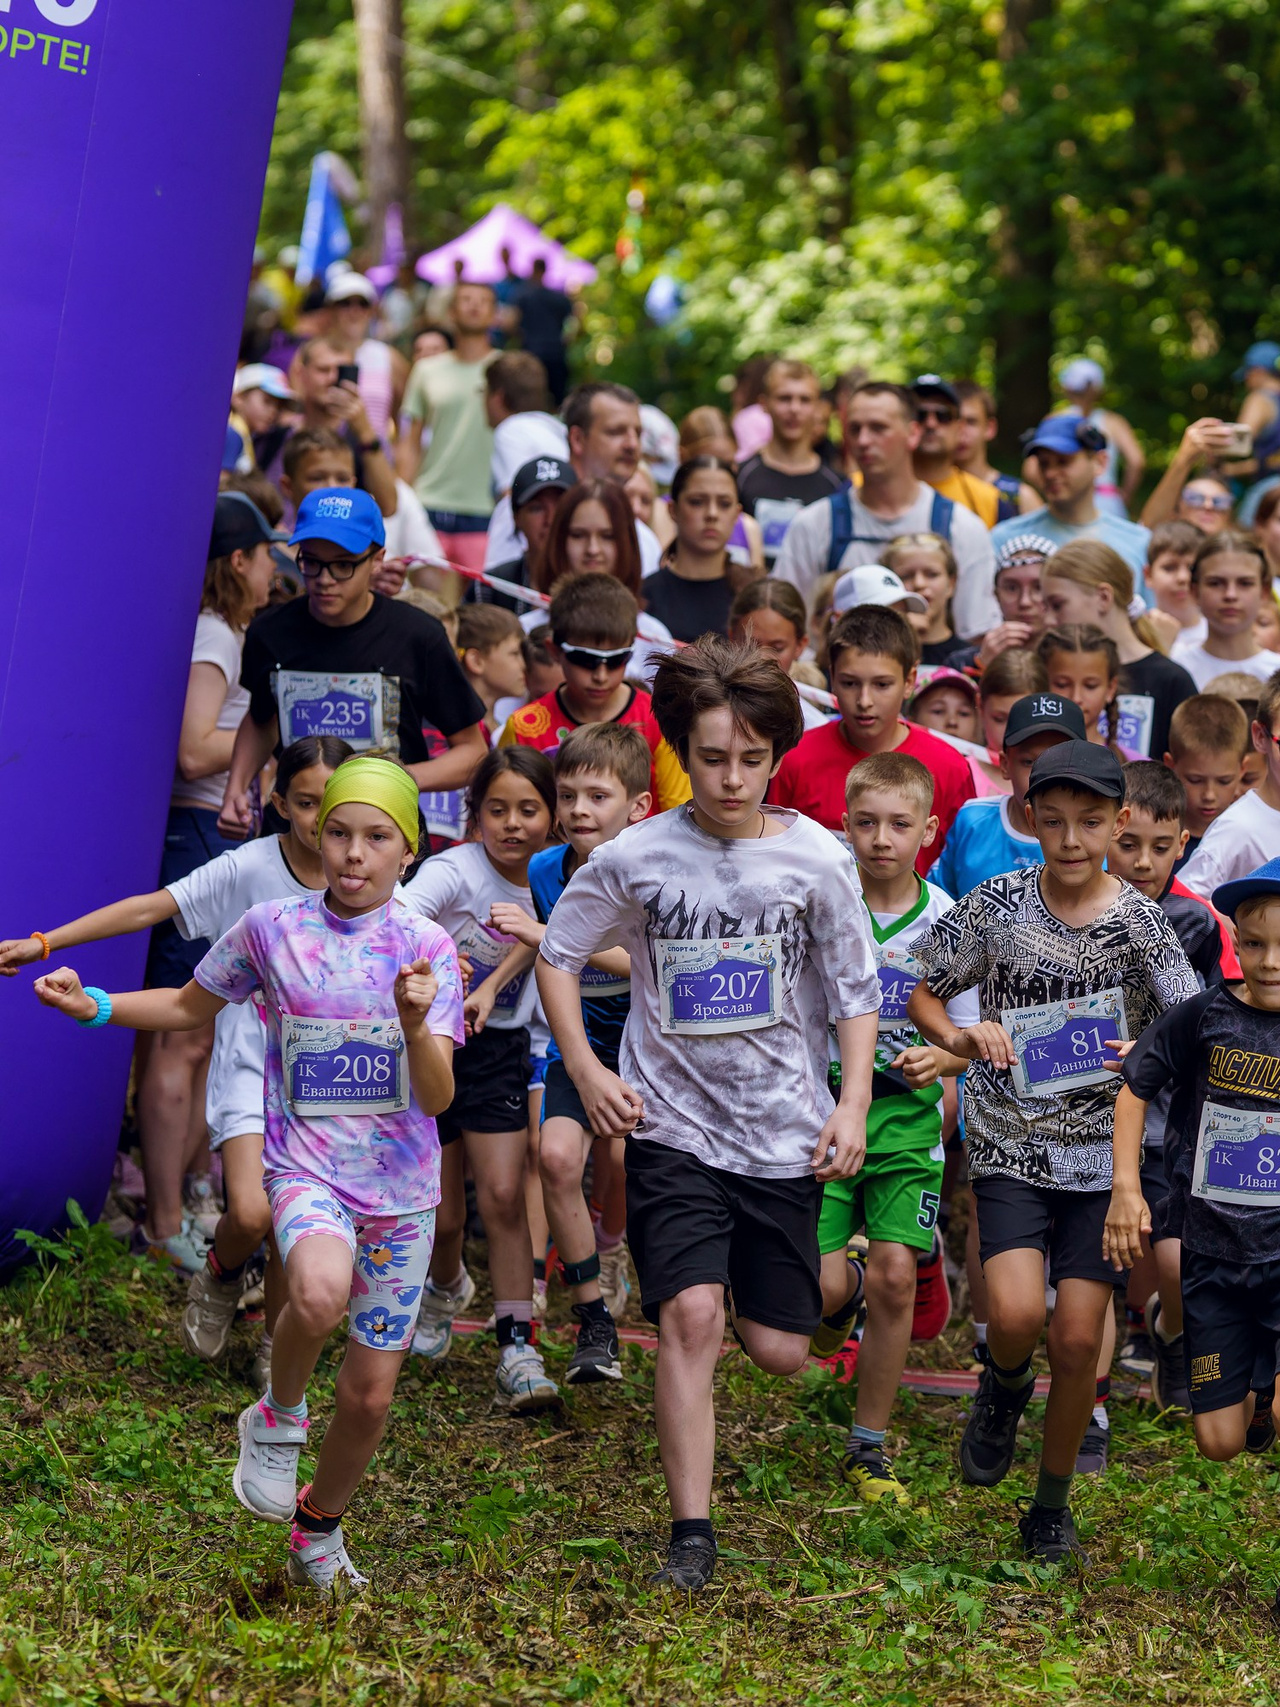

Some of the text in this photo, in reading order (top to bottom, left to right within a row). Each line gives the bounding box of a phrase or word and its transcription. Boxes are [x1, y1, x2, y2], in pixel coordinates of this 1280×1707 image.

[315, 504, 351, 519] 2030
[321, 701, 366, 725] 235
[307, 724, 355, 736] Максим
[709, 969, 764, 1001] 207
[692, 1003, 752, 1019] Ярослав
[1070, 1026, 1107, 1057] 81
[332, 1054, 391, 1083] 208
[301, 1083, 389, 1097] Евангелина
[1238, 1173, 1277, 1188] Иван
[916, 1189, 940, 1230] 5
